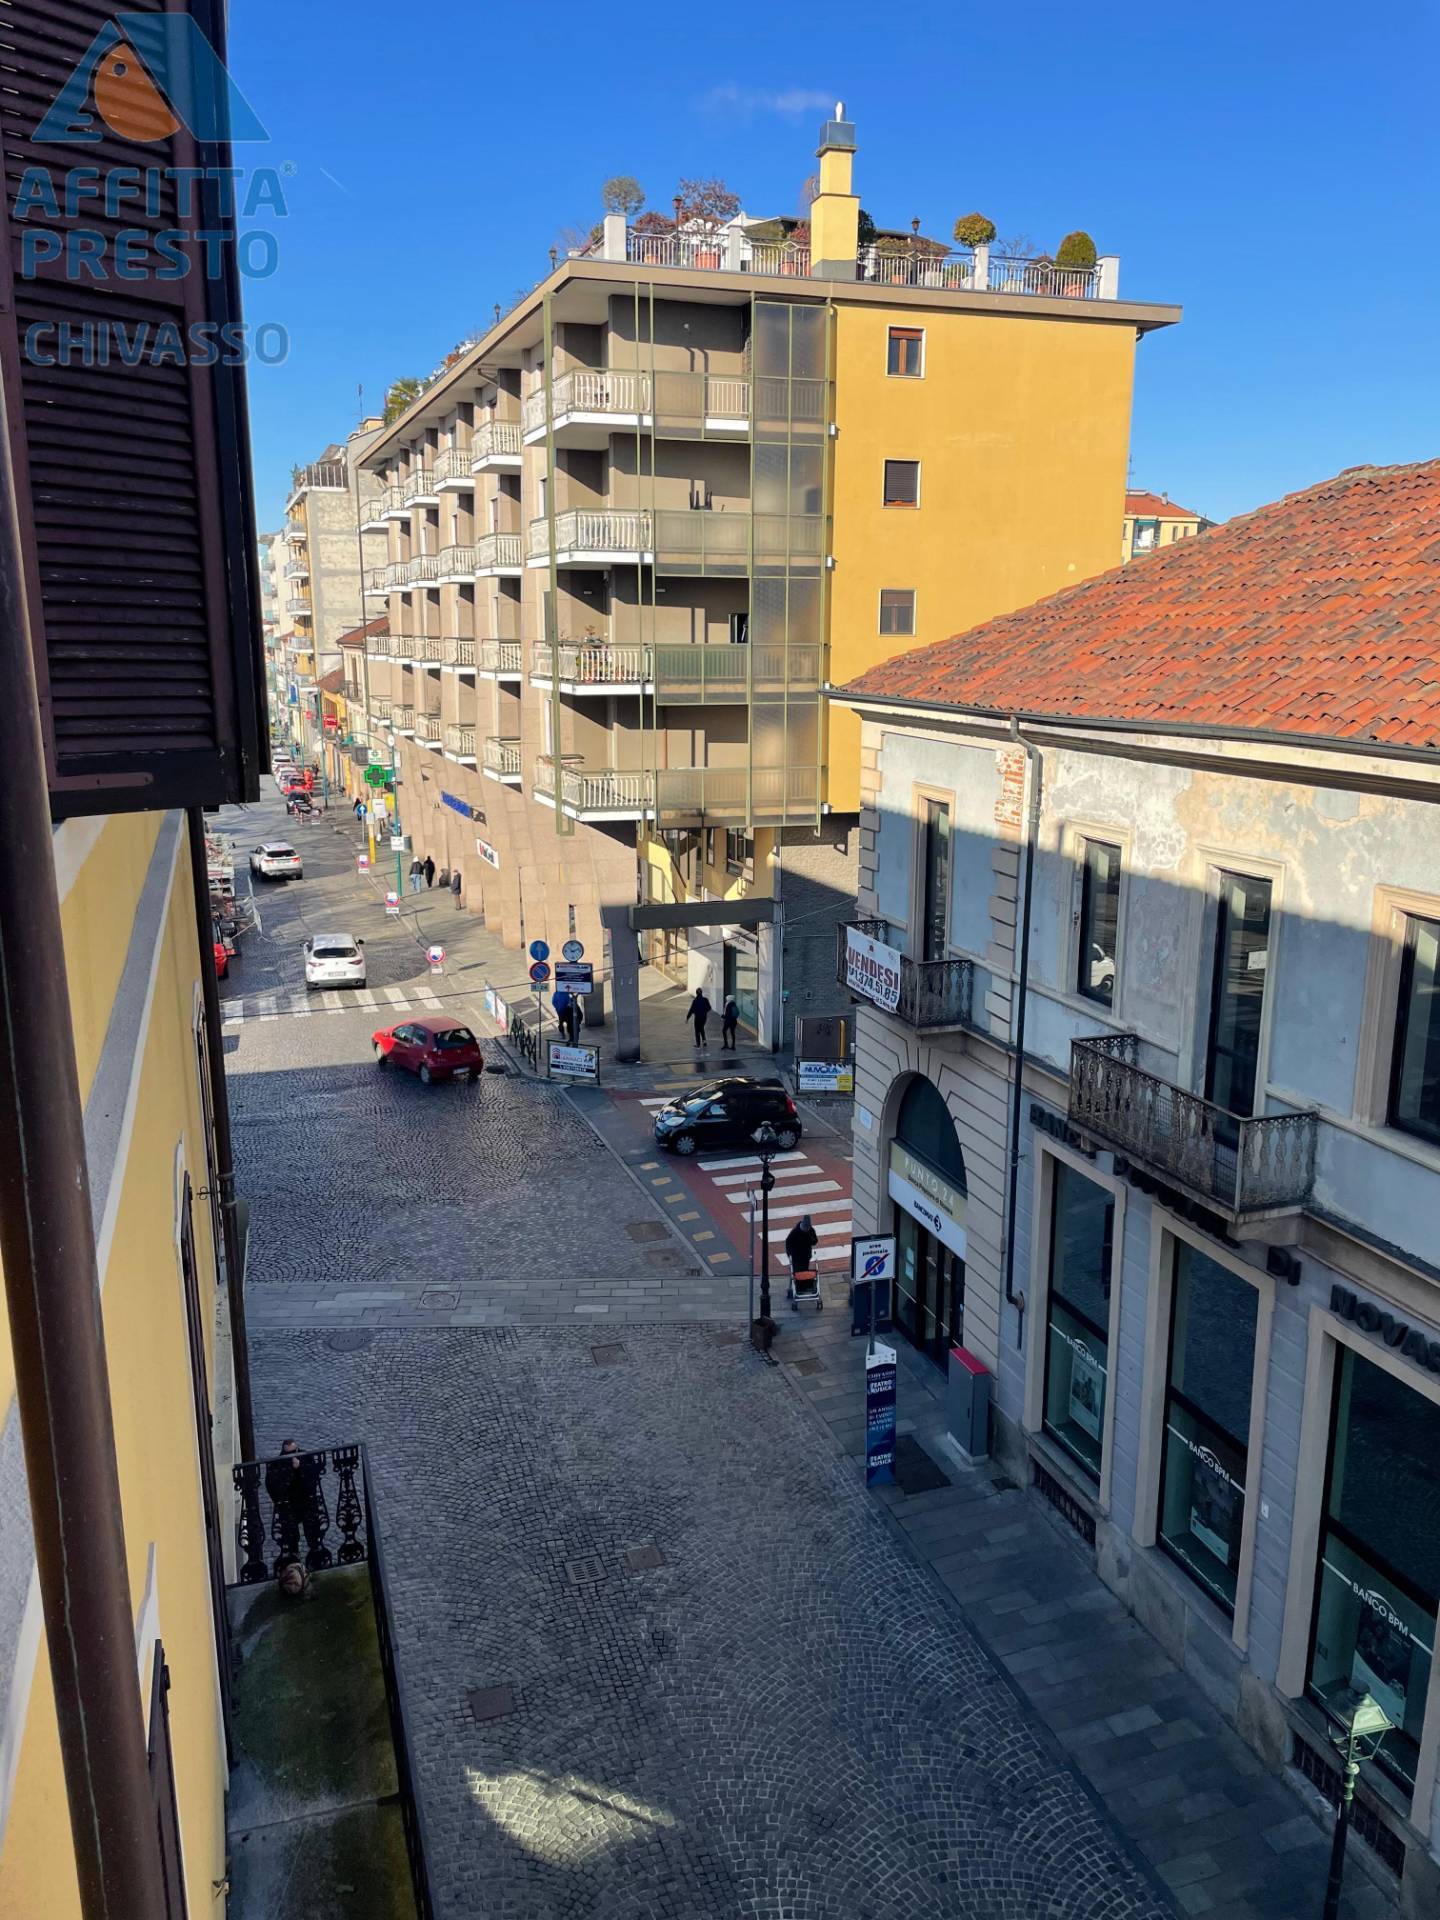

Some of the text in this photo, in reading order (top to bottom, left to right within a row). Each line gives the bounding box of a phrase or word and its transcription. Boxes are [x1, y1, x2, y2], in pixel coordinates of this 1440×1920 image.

[848, 946, 899, 990] VENDESI
[1030, 1104, 1097, 1160] BANC
[1266, 1246, 1302, 1286] DI
[1189, 1440, 1230, 1483] BANCO BPM
[1352, 1582, 1408, 1636] BANCO BPM
